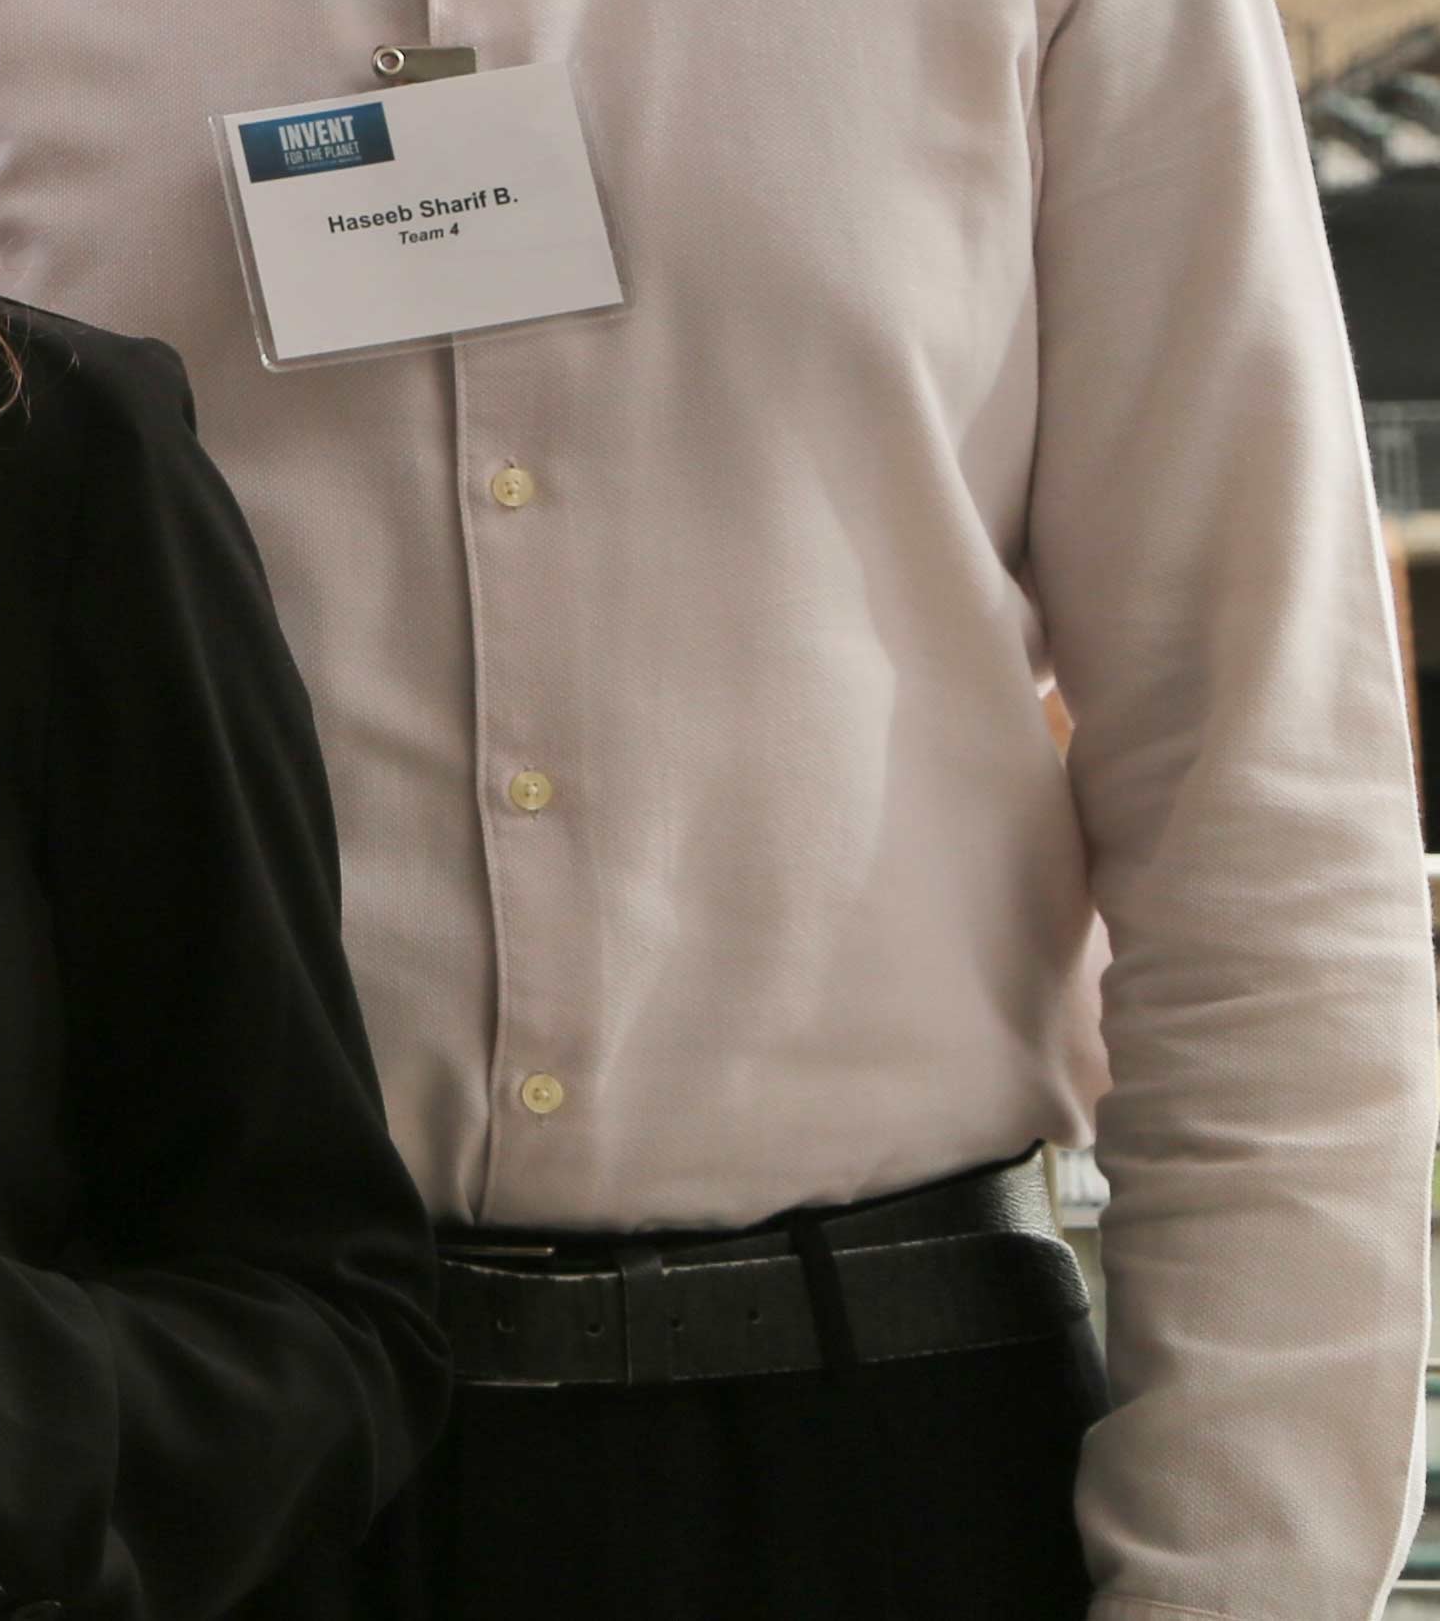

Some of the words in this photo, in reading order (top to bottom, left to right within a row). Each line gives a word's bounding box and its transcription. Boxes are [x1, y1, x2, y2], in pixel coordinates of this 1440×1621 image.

[278, 115, 354, 151] INVENT
[284, 151, 304, 166] FOR
[305, 148, 322, 162] THE
[324, 141, 360, 158] PLANET
[328, 205, 412, 233] Haseeb
[419, 190, 487, 218] Sharif
[494, 187, 518, 205] B.
[398, 227, 444, 245] Team
